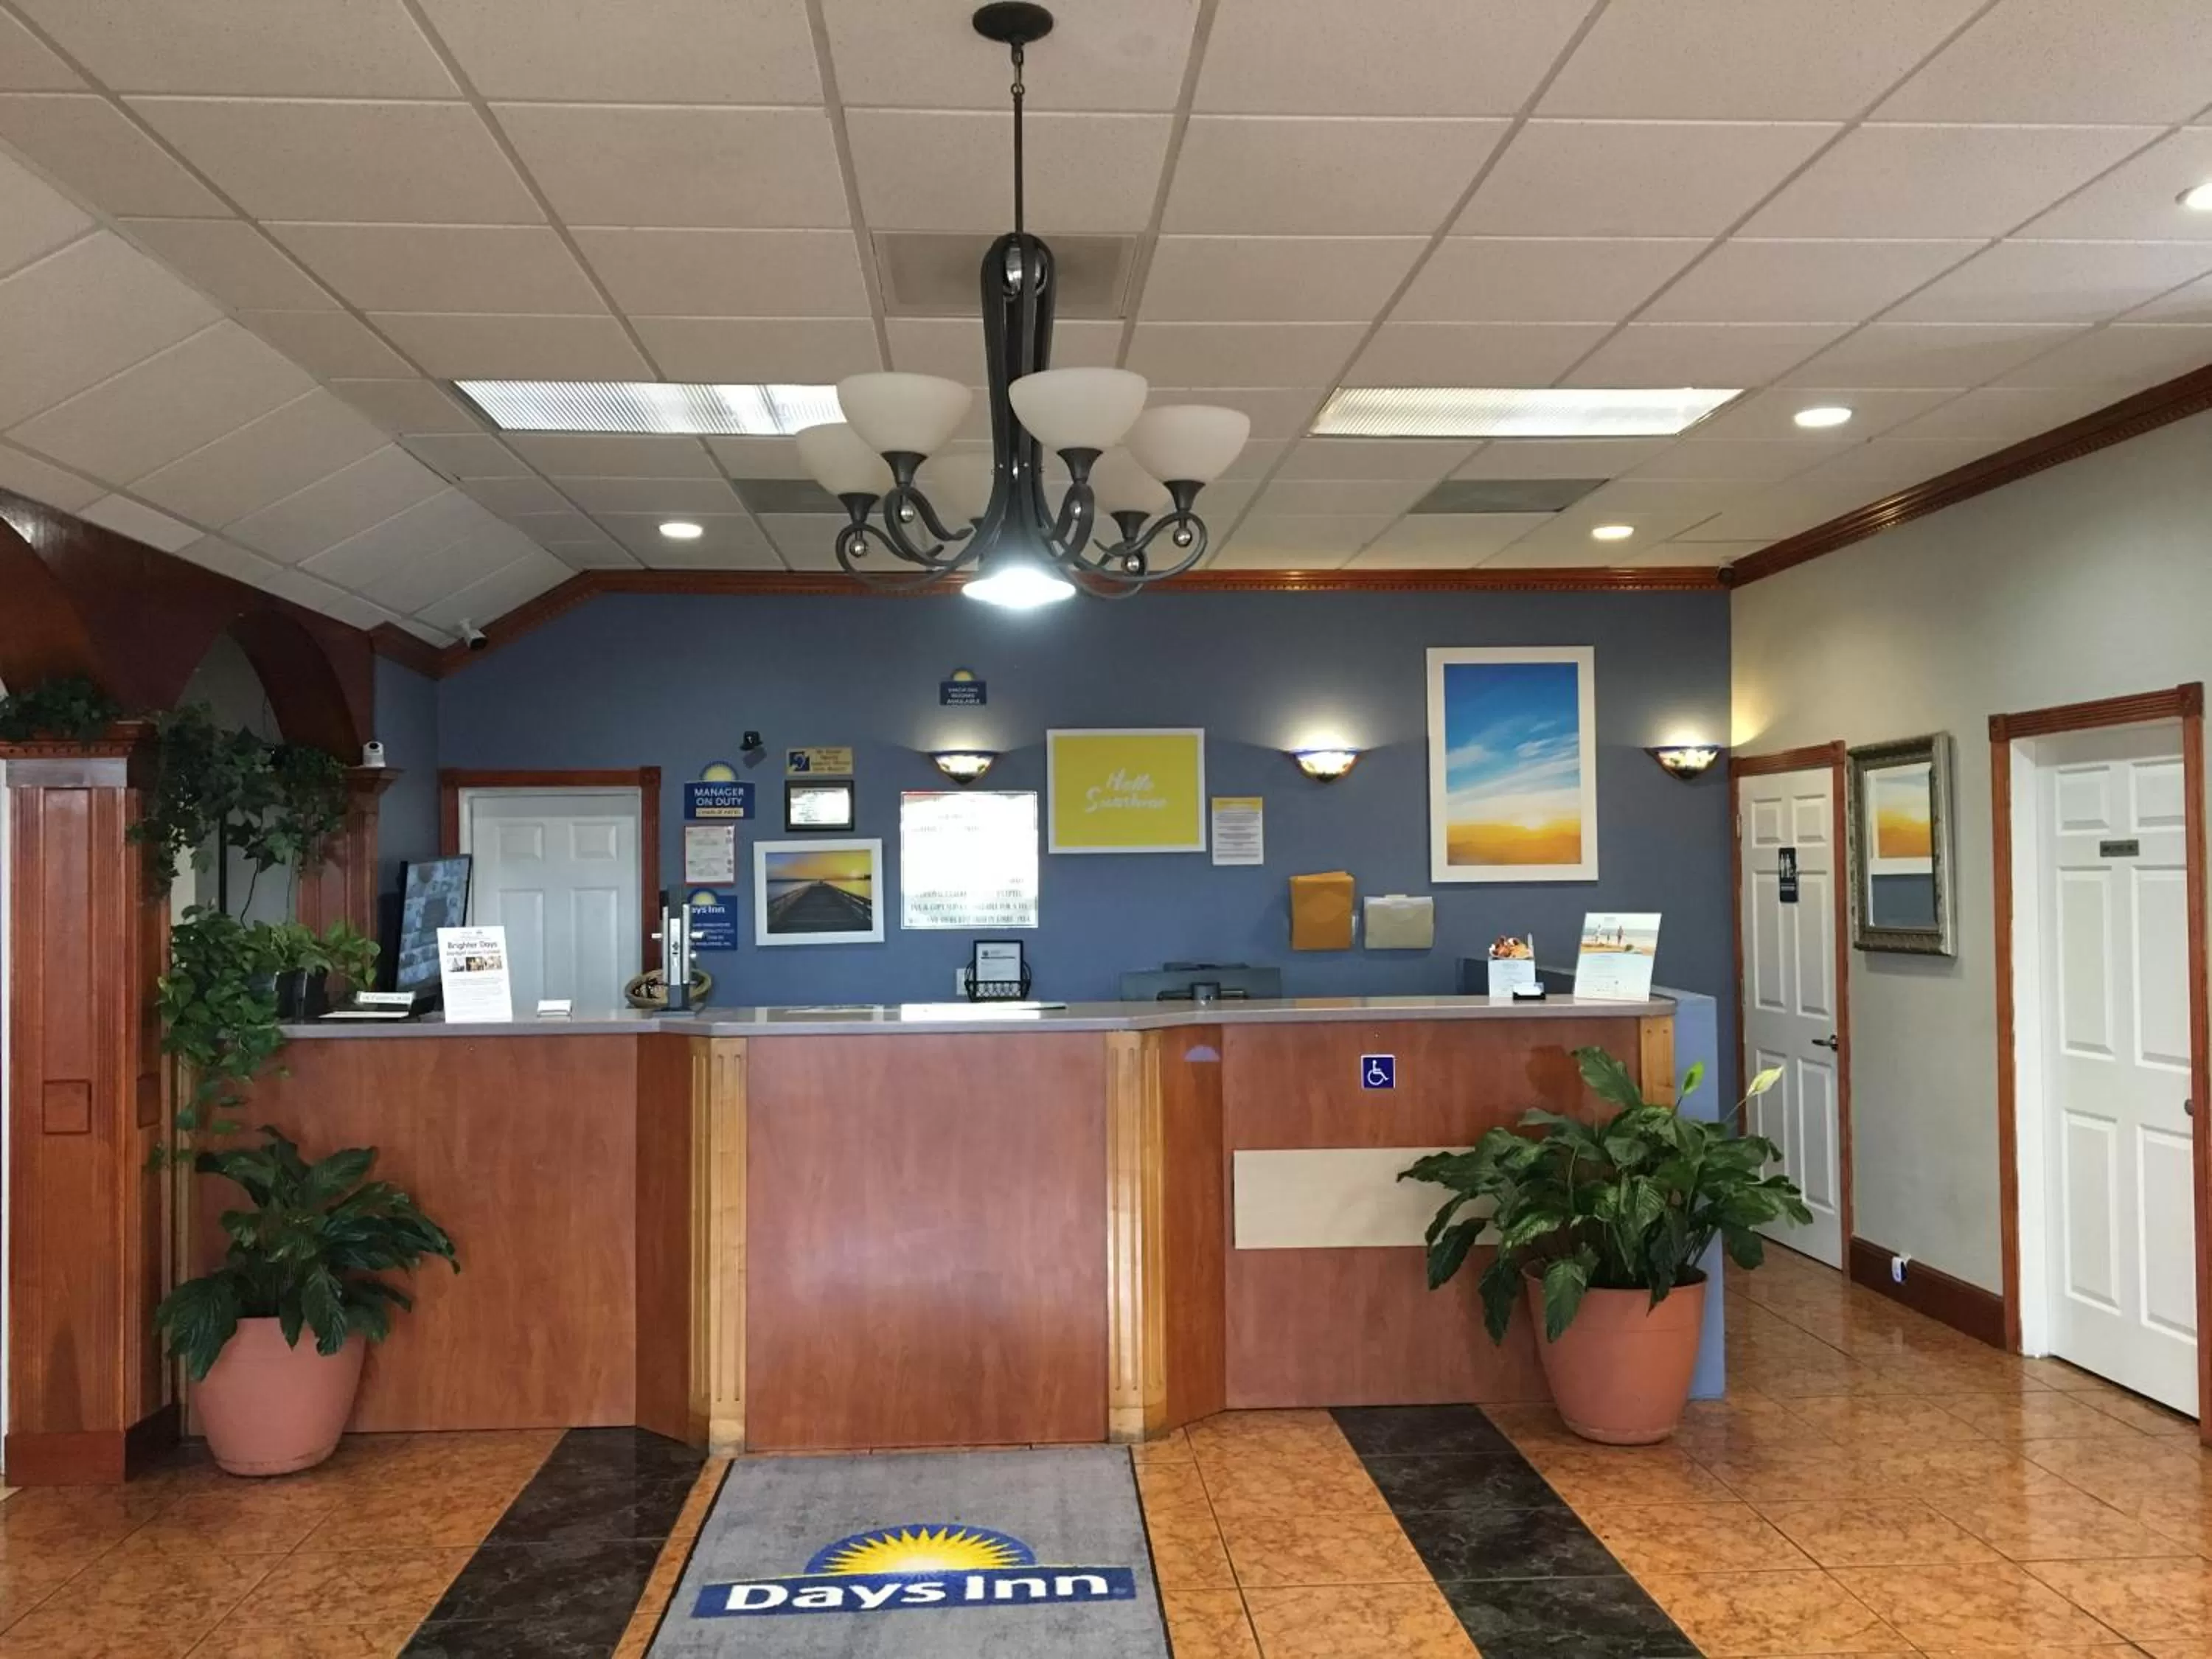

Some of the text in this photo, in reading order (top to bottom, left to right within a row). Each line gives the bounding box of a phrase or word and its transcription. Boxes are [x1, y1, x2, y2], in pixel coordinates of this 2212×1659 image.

[1106, 767, 1155, 791] Hello
[694, 787, 744, 796] MANAGER
[696, 797, 742, 806] ON DUTY
[691, 905, 726, 915] ays Inn
[447, 940, 498, 950] Brighter Days
[724, 1574, 1108, 1610] Days Inn
